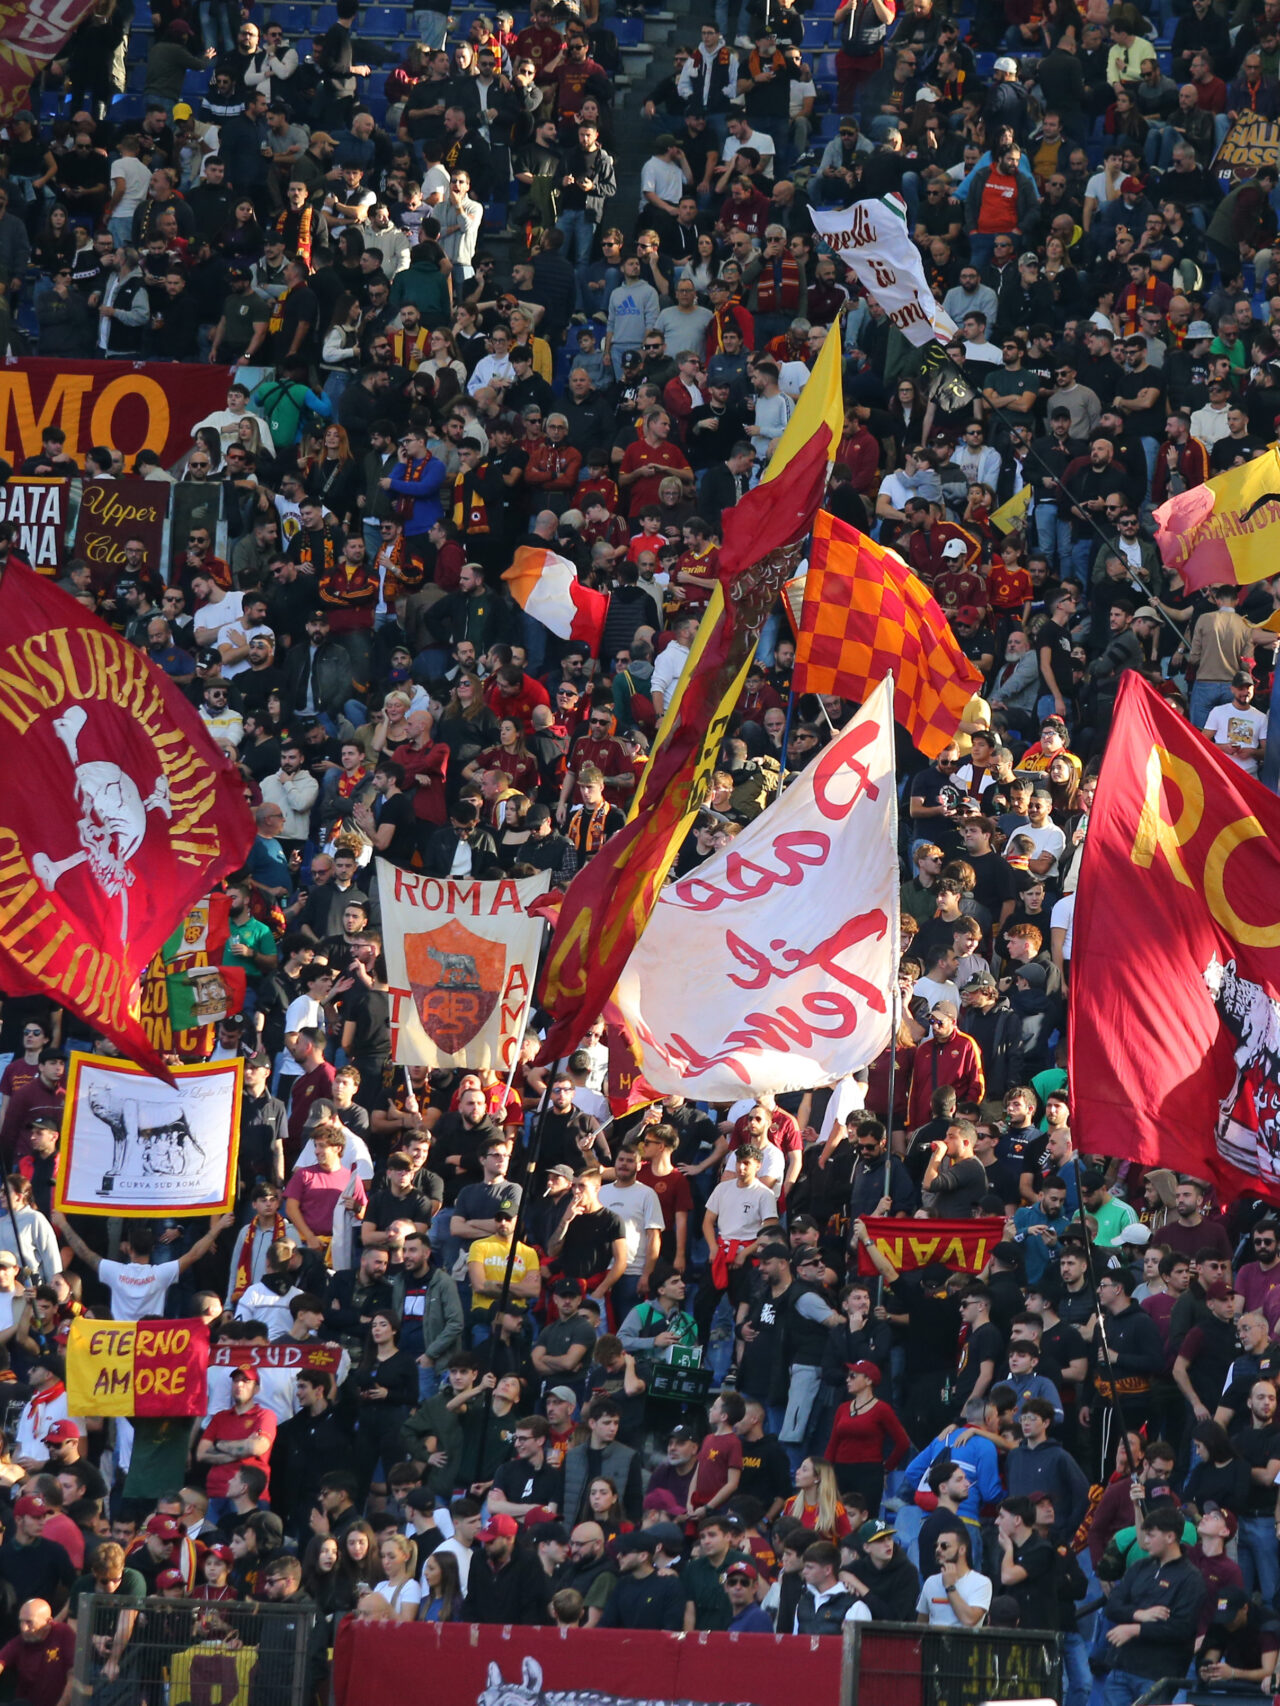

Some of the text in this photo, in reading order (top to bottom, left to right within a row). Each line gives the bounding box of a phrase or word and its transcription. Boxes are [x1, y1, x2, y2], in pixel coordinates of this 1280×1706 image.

[1218, 143, 1279, 166] ROSS
[83, 486, 157, 527] Upper
[394, 868, 523, 916] ROMA
[119, 1181, 150, 1189] CURVA
[175, 1180, 200, 1189] ROMA
[876, 1237, 986, 1270] IVAN
[90, 1329, 190, 1356] ETERNO
[251, 1346, 301, 1366] SUD
[93, 1367, 187, 1396] AMORE
